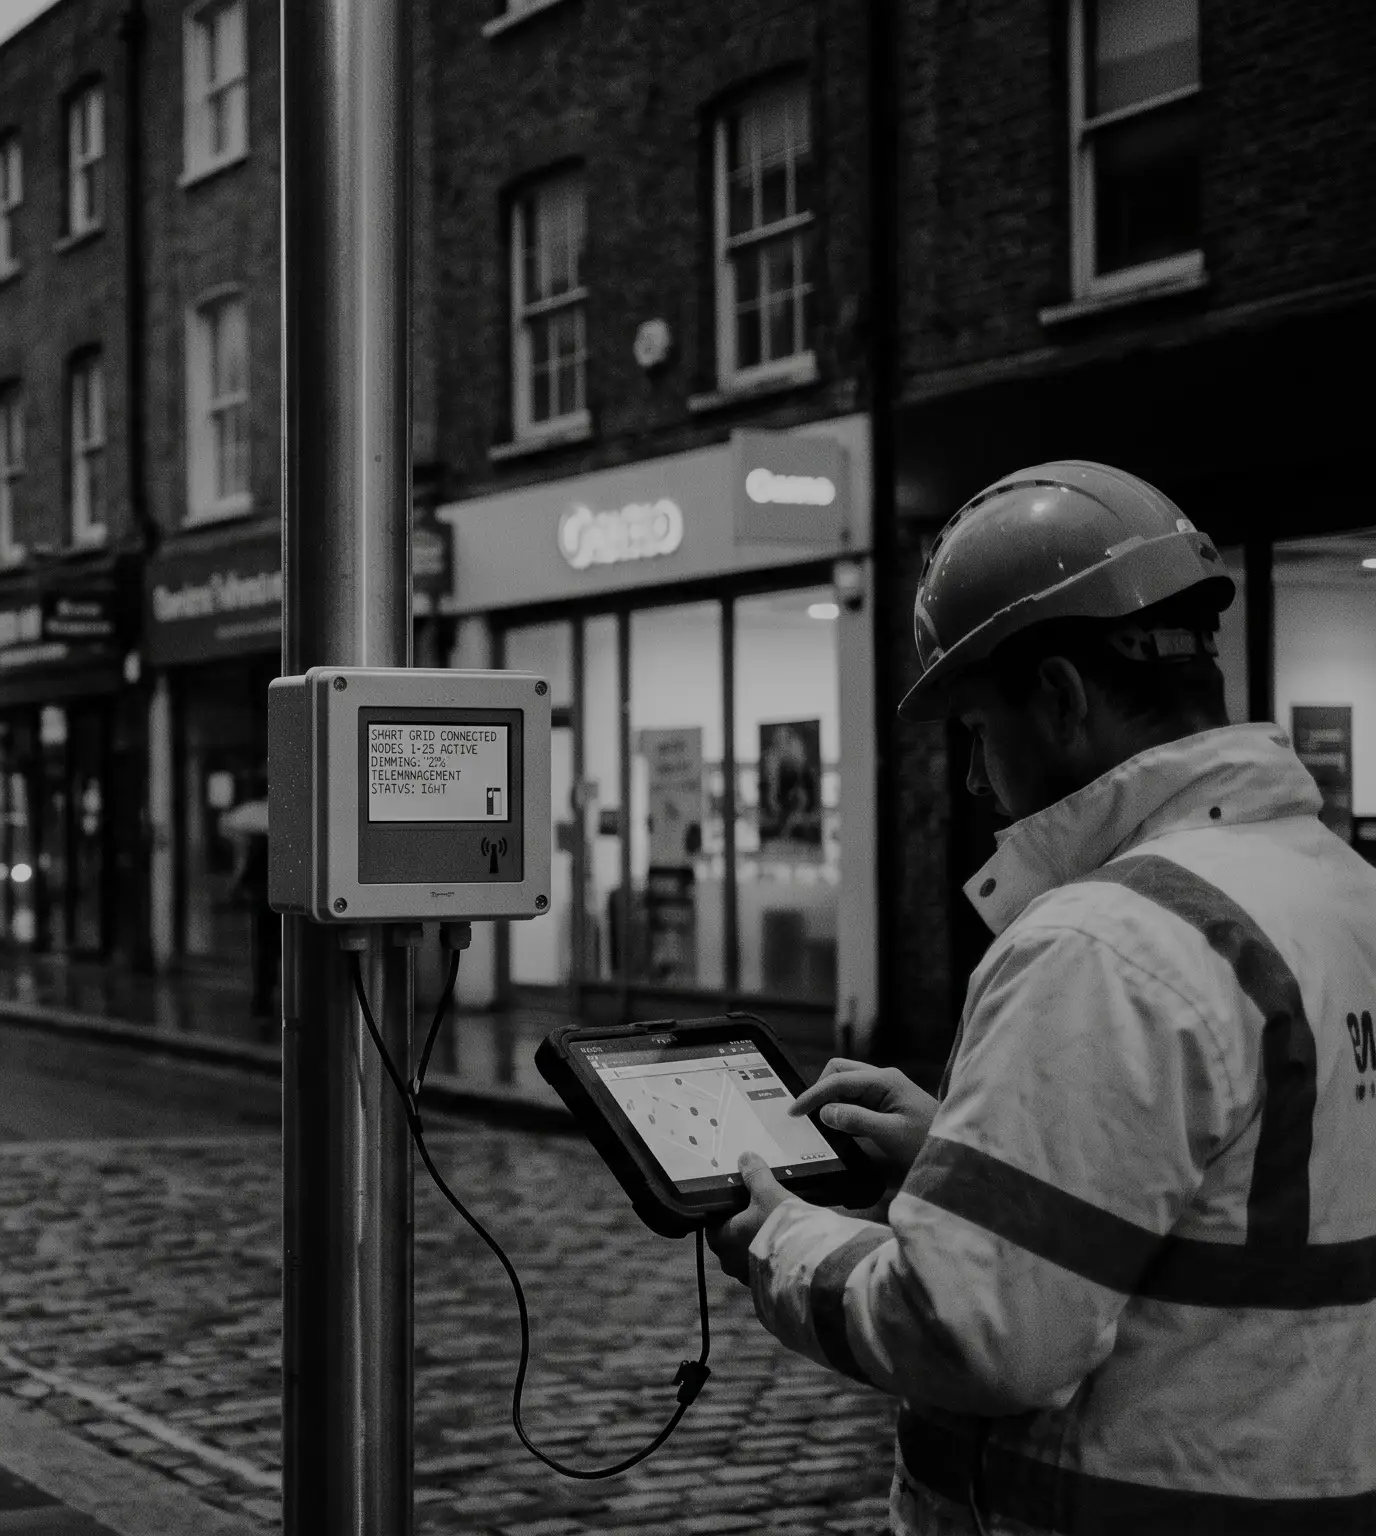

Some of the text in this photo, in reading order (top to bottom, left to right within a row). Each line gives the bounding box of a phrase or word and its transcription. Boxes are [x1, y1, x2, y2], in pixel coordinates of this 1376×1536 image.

[409, 730, 436, 741] GRID
[440, 731, 497, 742] CONNECTED
[371, 743, 478, 755] NODES 1-25 ACTIVE
